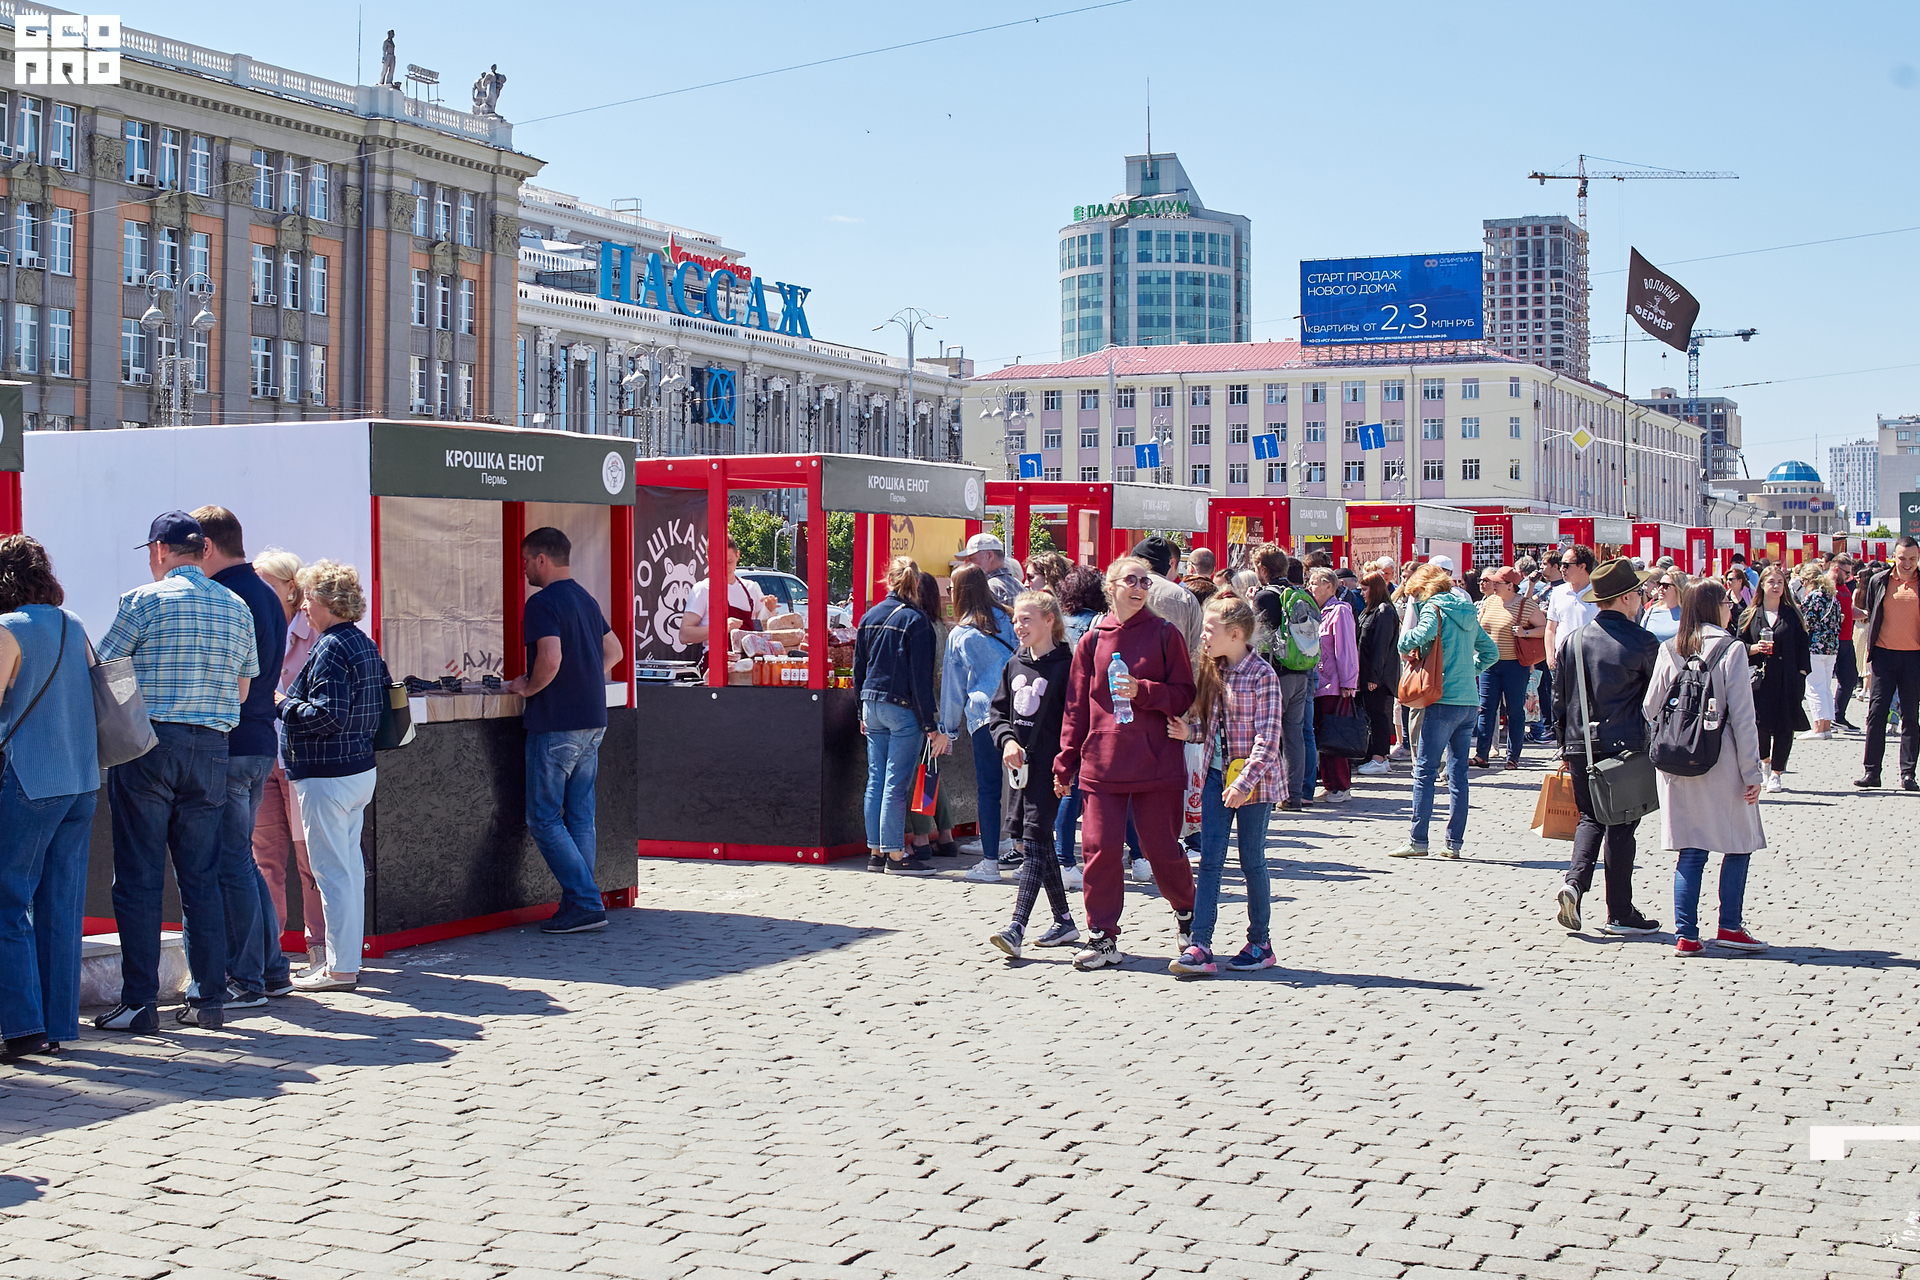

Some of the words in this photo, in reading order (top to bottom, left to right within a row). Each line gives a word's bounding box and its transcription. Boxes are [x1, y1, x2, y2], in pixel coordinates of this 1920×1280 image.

[1087, 200, 1191, 219] ПАЛЛАДИУМ
[1307, 272, 1345, 284] СТАРТ
[1347, 269, 1402, 283] ПРОДАЖ
[596, 240, 813, 339] ПАССАЖ
[1307, 284, 1356, 296] НОВОГО
[1358, 283, 1397, 295] ДОМА
[1643, 278, 1681, 304] ВОЛЬНЫЙ
[1308, 323, 1360, 334] КВАРТИРЫ
[1363, 323, 1377, 332] ОТ
[1380, 303, 1428, 334] 2,3
[1431, 319, 1454, 328] МЛН
[1634, 304, 1673, 331] ФЕРМЕР
[445, 449, 505, 470] КРОШКА
[508, 453, 545, 472] ЕНОТ
[481, 473, 508, 487] Пермь
[867, 475, 905, 491] КРОШКА
[906, 479, 930, 493] ЕНОТ
[889, 493, 906, 503] Пермь
[1299, 509, 1313, 519] GRAND
